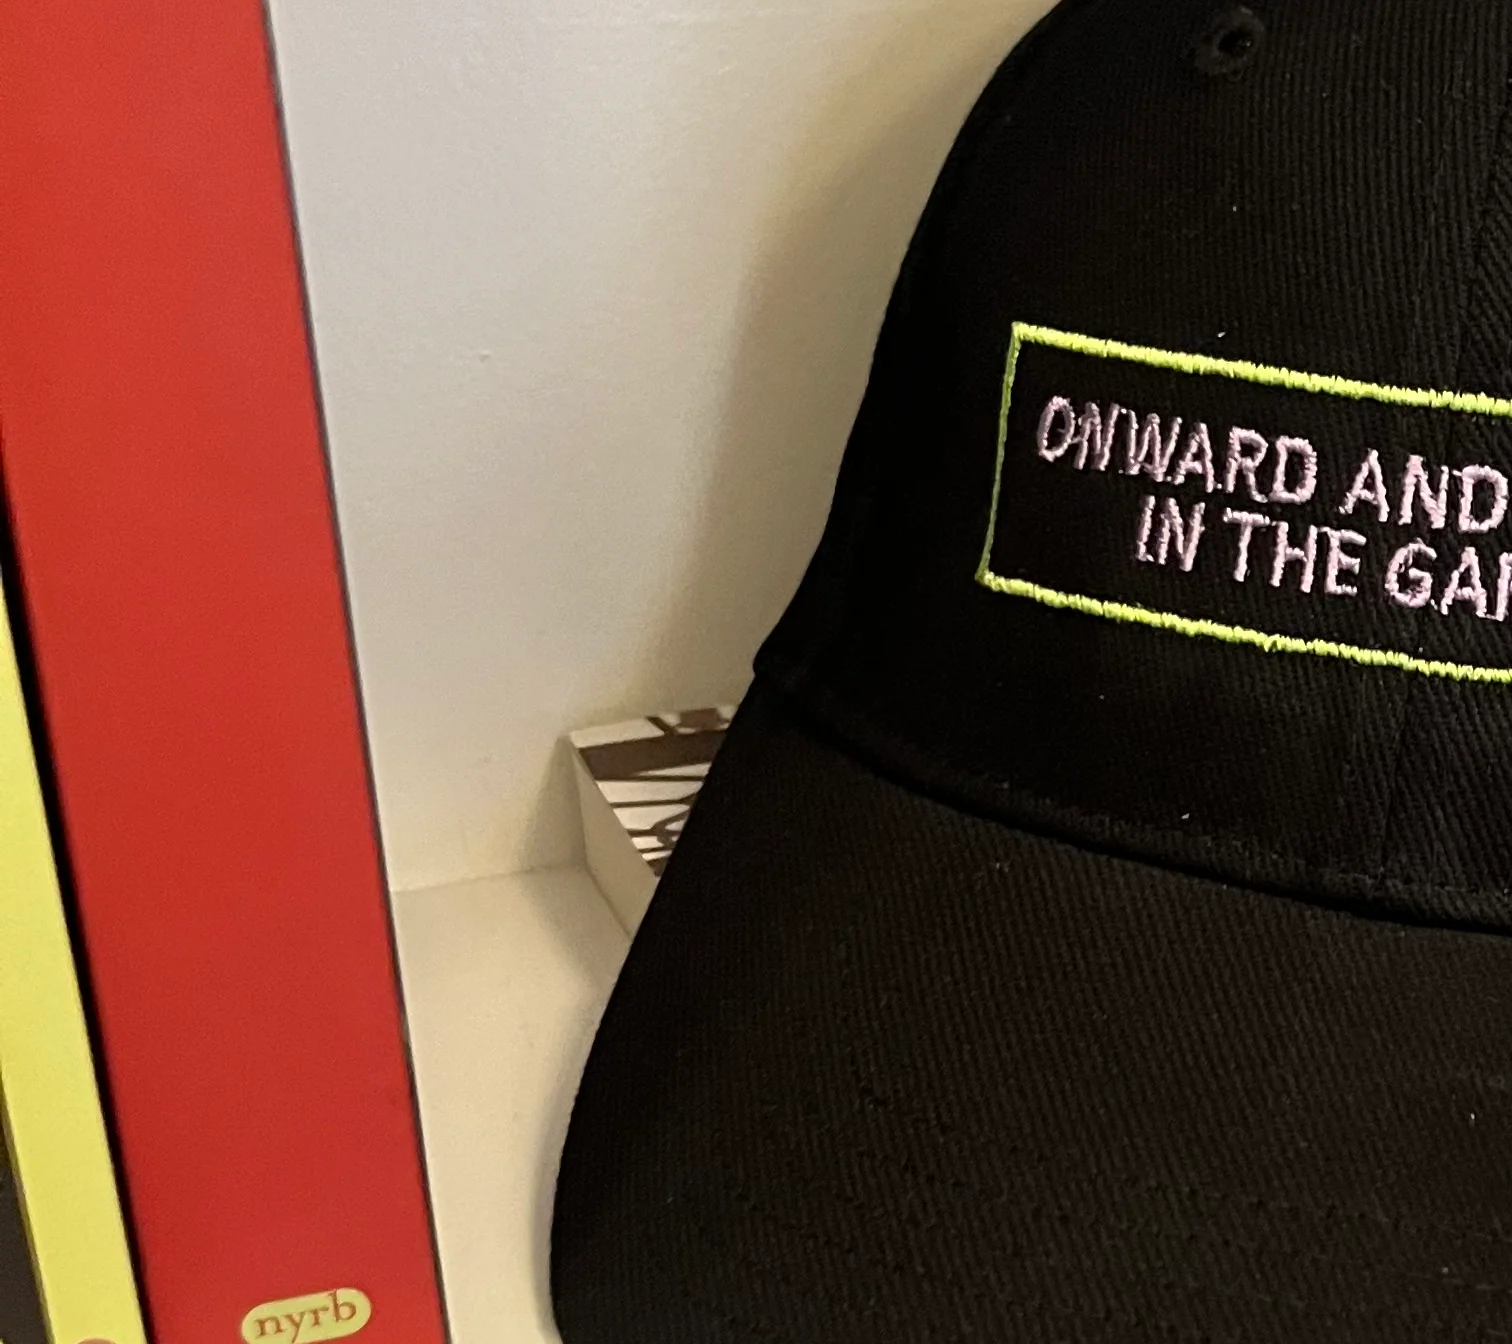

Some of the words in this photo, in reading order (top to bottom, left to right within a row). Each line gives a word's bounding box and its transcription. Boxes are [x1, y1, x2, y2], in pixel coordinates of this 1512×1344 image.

[1035, 394, 1317, 506] ONWARD
[1339, 451, 1509, 535] AND
[1135, 494, 1205, 573] IN
[1222, 510, 1368, 597] THE
[254, 1288, 357, 1344] nyrb
